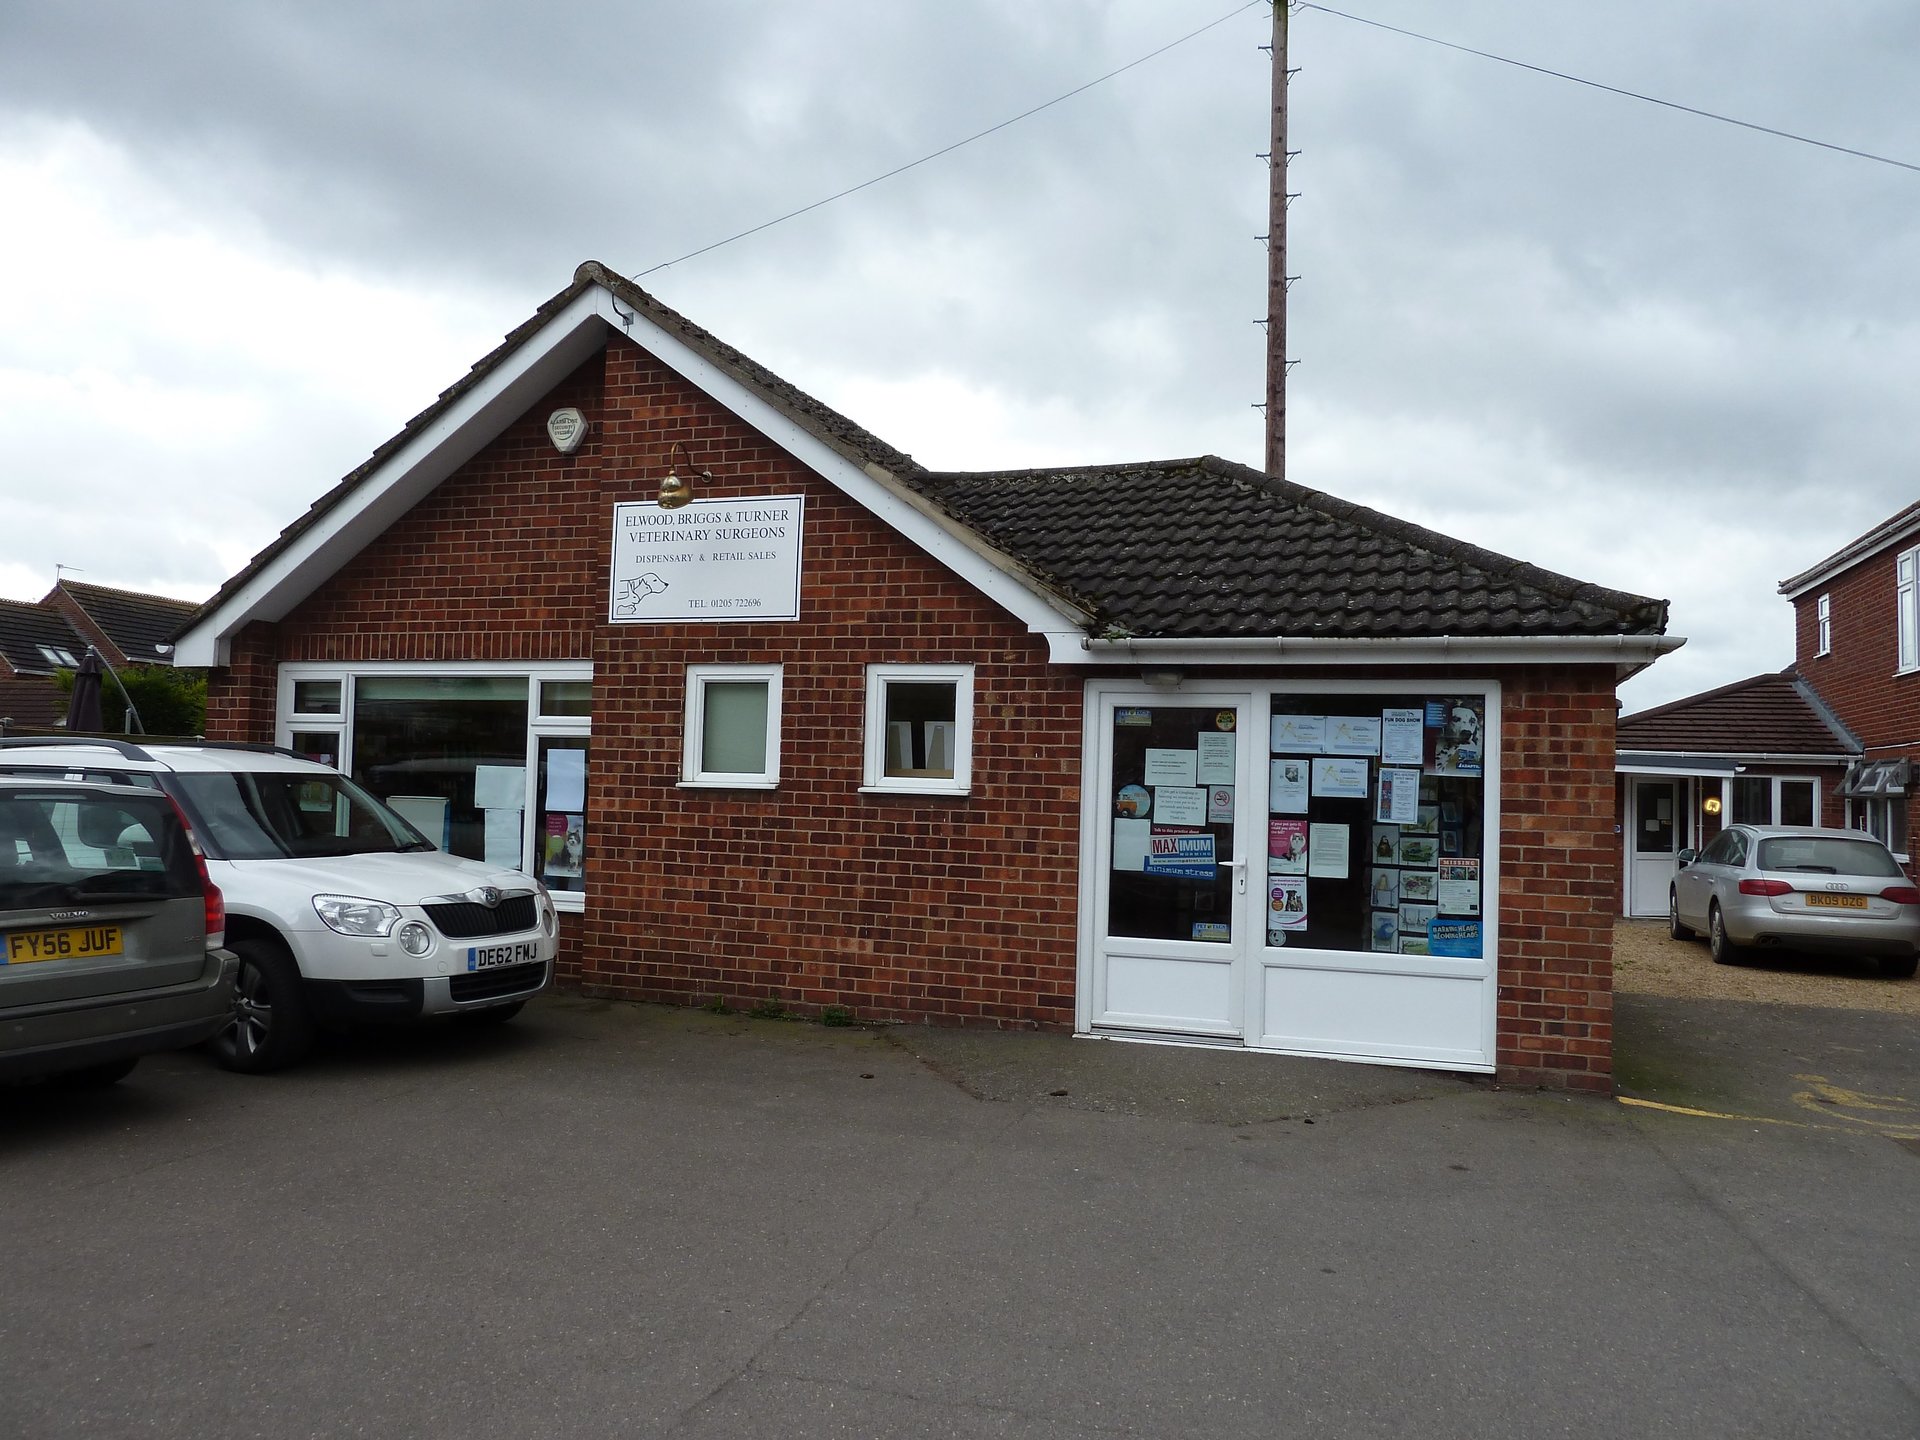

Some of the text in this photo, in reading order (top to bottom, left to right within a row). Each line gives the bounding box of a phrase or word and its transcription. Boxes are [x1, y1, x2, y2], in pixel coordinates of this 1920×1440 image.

[625, 509, 789, 527] ELWOOD, BRIGGS & TURNER
[629, 526, 785, 543] VETERINARY SURGEONS
[635, 551, 777, 564] DISPENSARY & RETAIL SALES
[710, 599, 733, 608] 01205
[734, 598, 762, 608] 722696
[1152, 837, 1211, 854] MAXIMUM
[1146, 865, 1214, 878] minimum stress
[50, 911, 89, 920] VOLVO
[10, 928, 118, 959] FY56 JUF
[478, 943, 537, 967] DE62 FMJ
